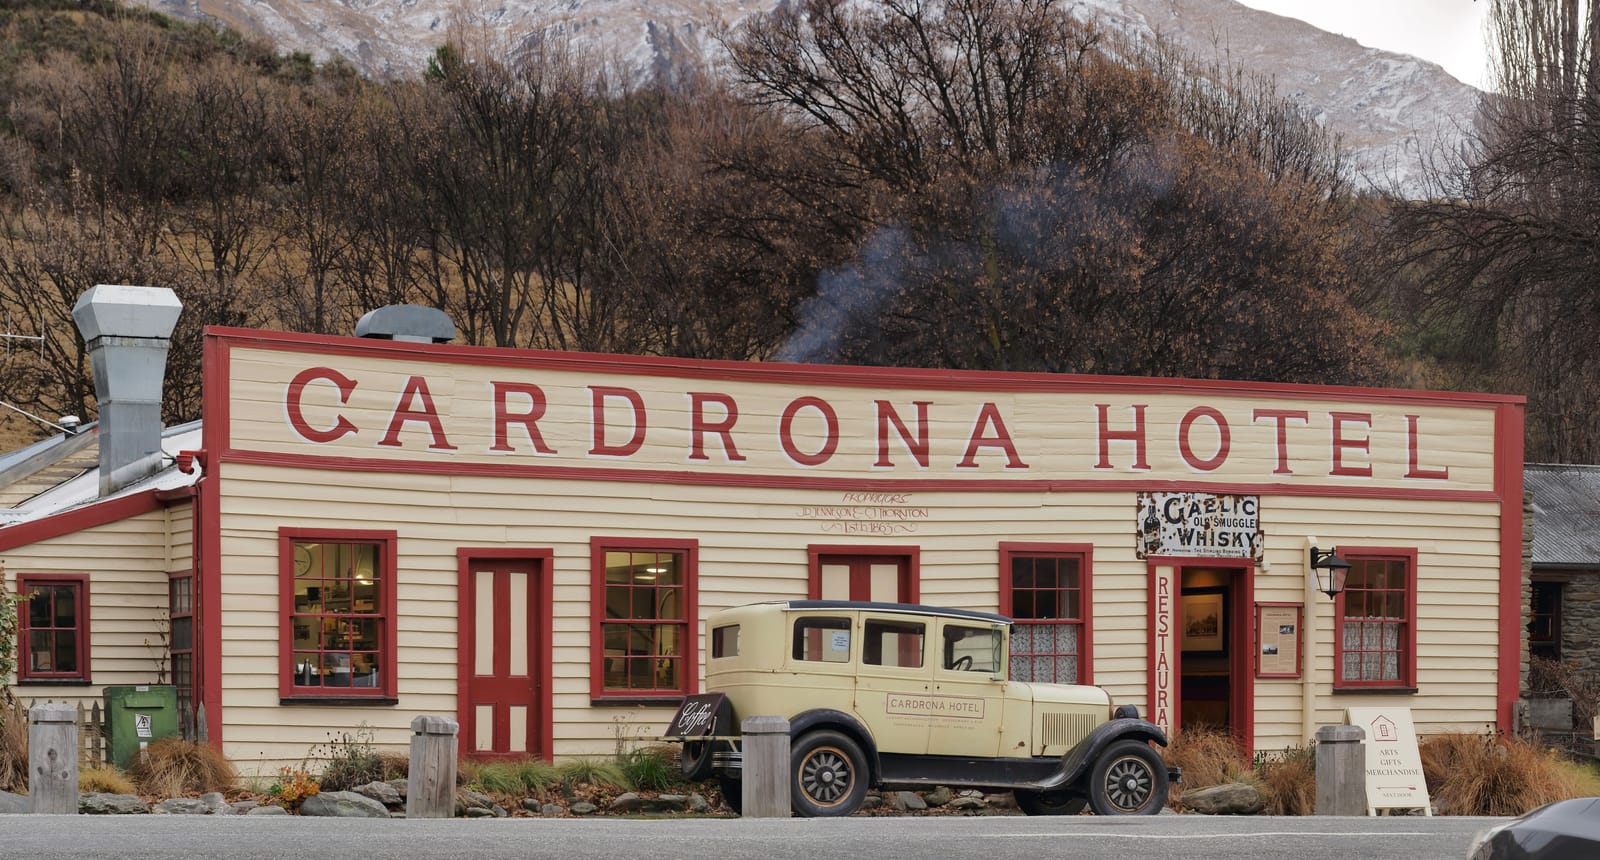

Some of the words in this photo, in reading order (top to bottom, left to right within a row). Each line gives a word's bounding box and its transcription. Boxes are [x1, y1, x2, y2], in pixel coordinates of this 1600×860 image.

[286, 366, 1030, 469] CARDRONA
[1093, 403, 1450, 480] HOTEL
[879, 508, 929, 520] THORNTON
[1177, 528, 1257, 548] WHISKY
[890, 698, 946, 711] CARDRONA
[948, 702, 980, 713] HOTEL
[678, 701, 712, 735] Coffee
